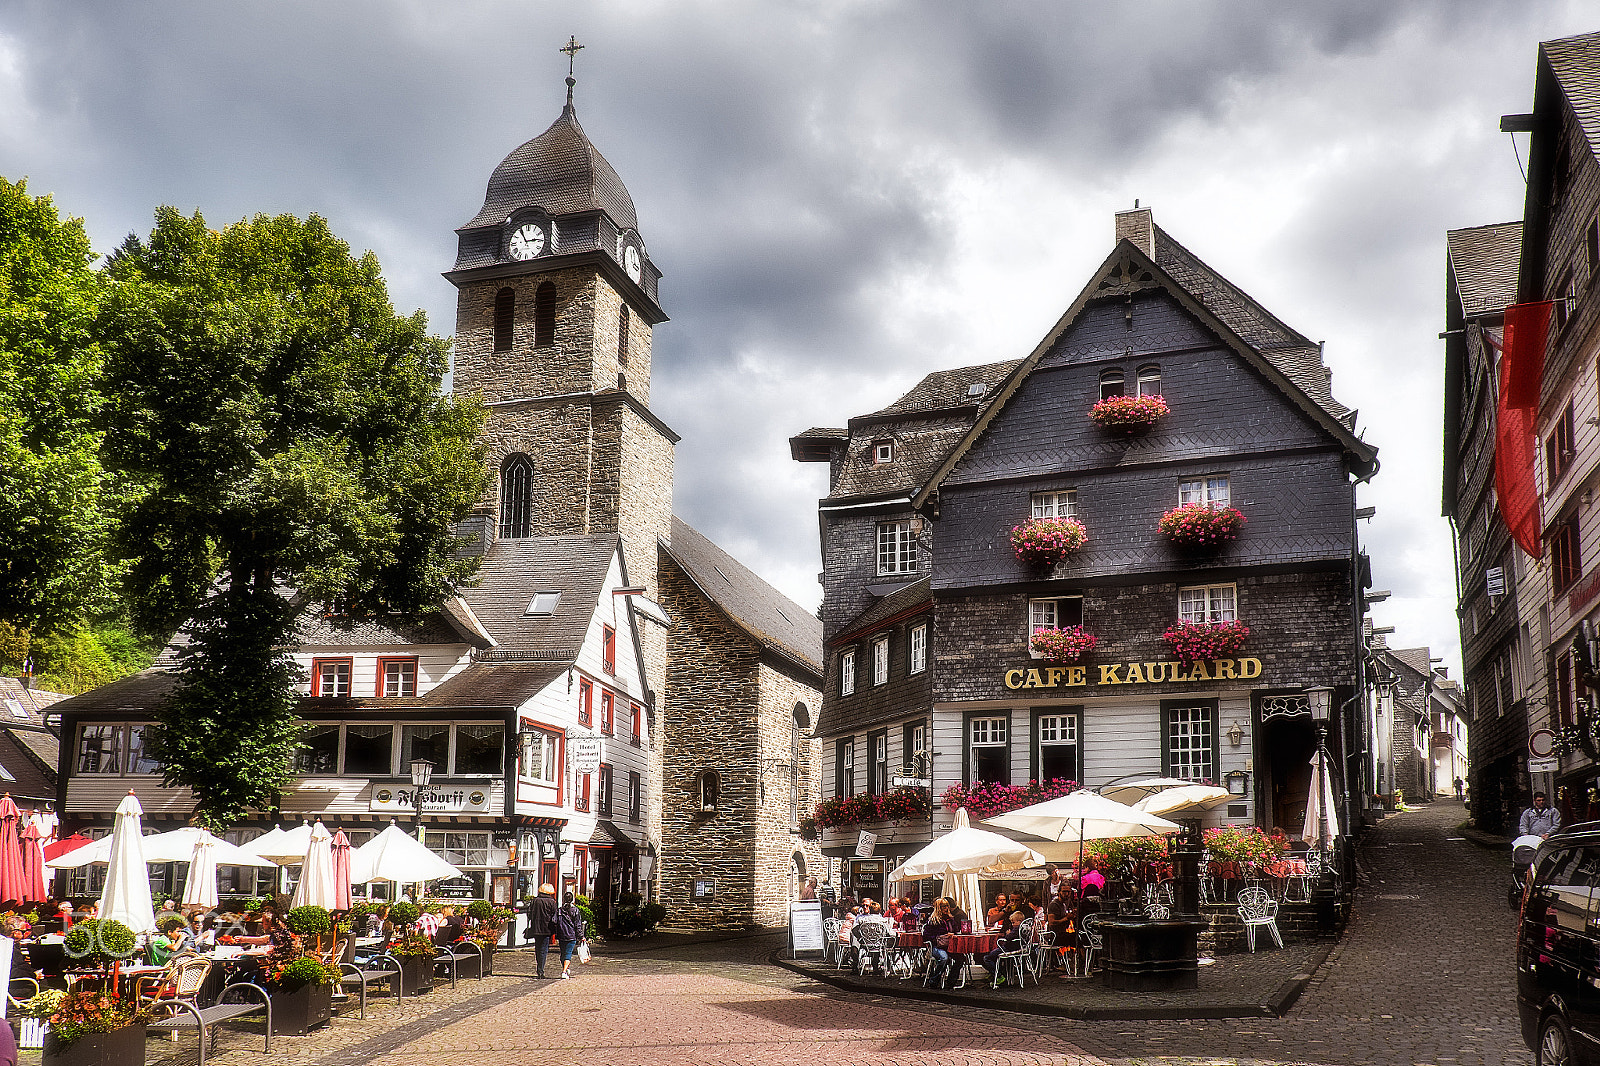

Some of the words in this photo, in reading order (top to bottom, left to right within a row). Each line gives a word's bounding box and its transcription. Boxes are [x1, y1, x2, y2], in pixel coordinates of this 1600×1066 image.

[1004, 665, 1087, 690] CAFE
[1098, 657, 1263, 685] KAULARD
[398, 790, 464, 806] Flsdorff
